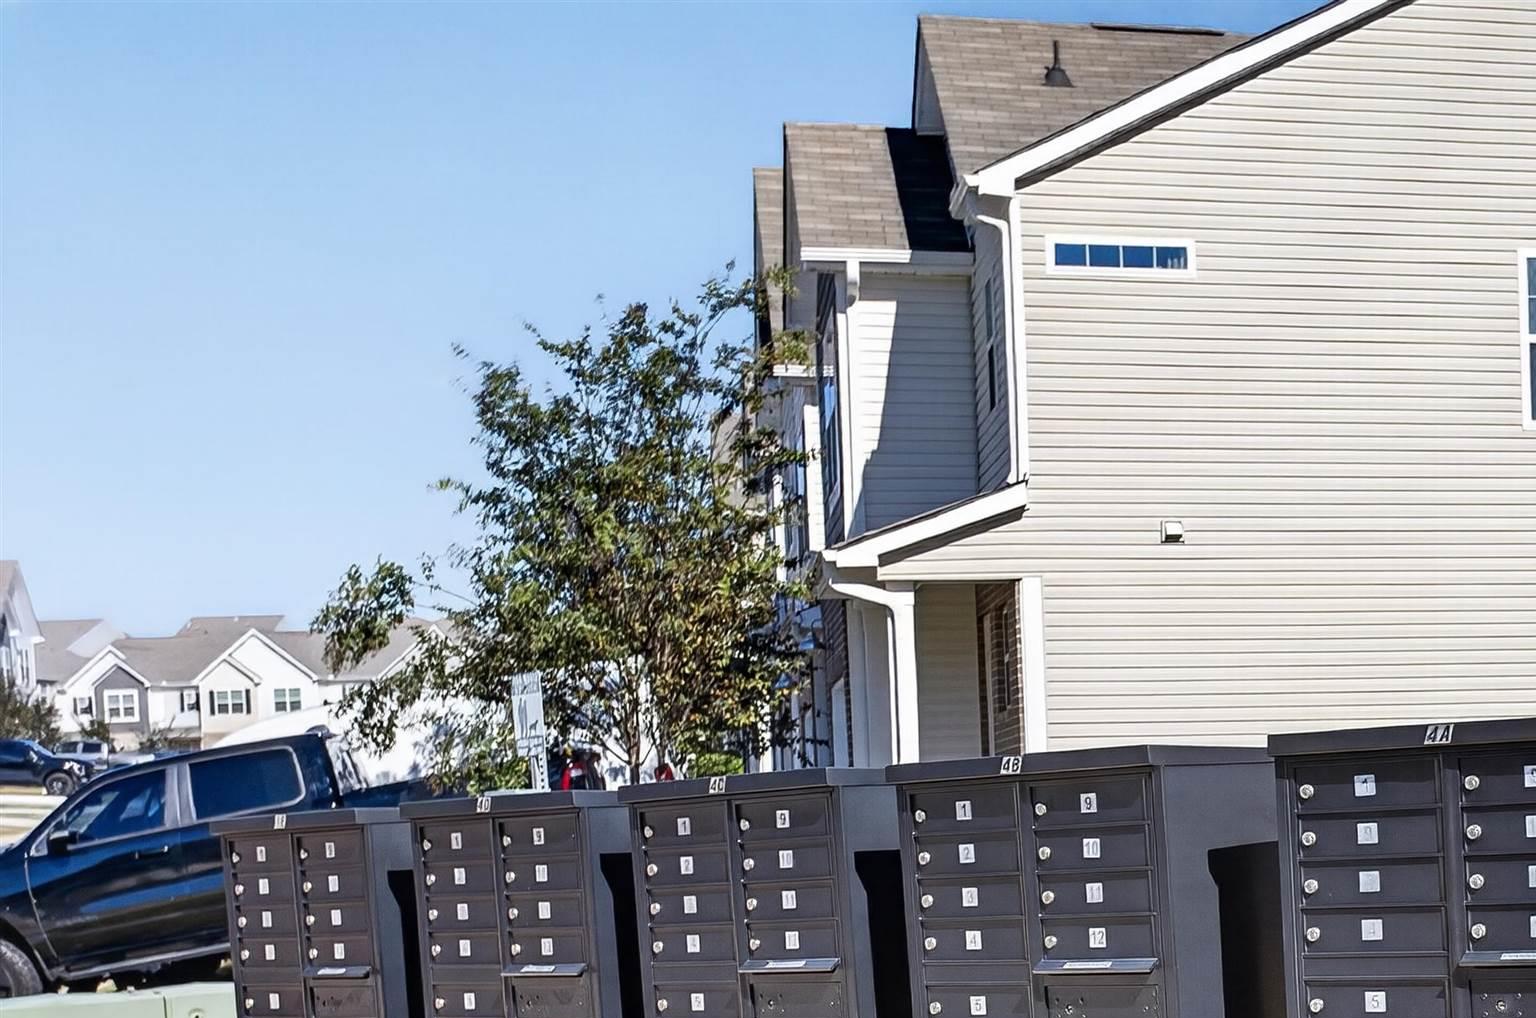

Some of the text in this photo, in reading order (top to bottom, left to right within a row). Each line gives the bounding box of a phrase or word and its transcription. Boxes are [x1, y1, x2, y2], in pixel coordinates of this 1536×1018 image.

[1426, 725, 1450, 743] 4A
[1002, 757, 1021, 773] 4B
[1371, 994, 1380, 1009] 5
